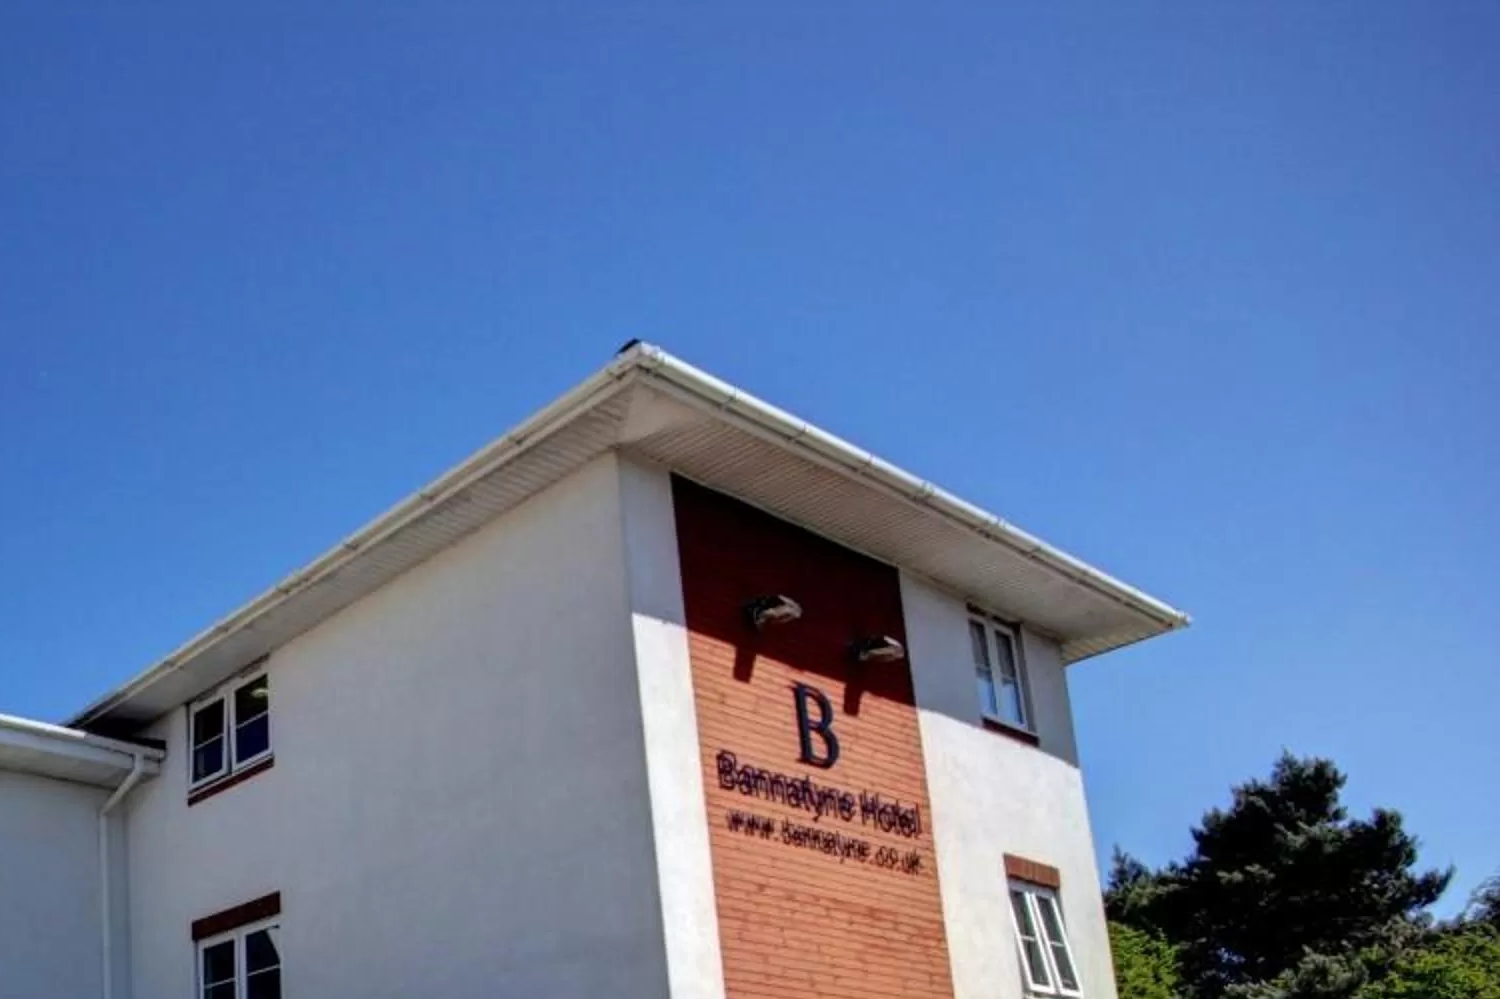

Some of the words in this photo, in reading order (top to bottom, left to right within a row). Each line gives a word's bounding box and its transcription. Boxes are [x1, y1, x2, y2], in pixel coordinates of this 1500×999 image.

[789, 680, 840, 769] B
[716, 749, 856, 824] Bannatyne
[859, 788, 921, 839] Hotel
